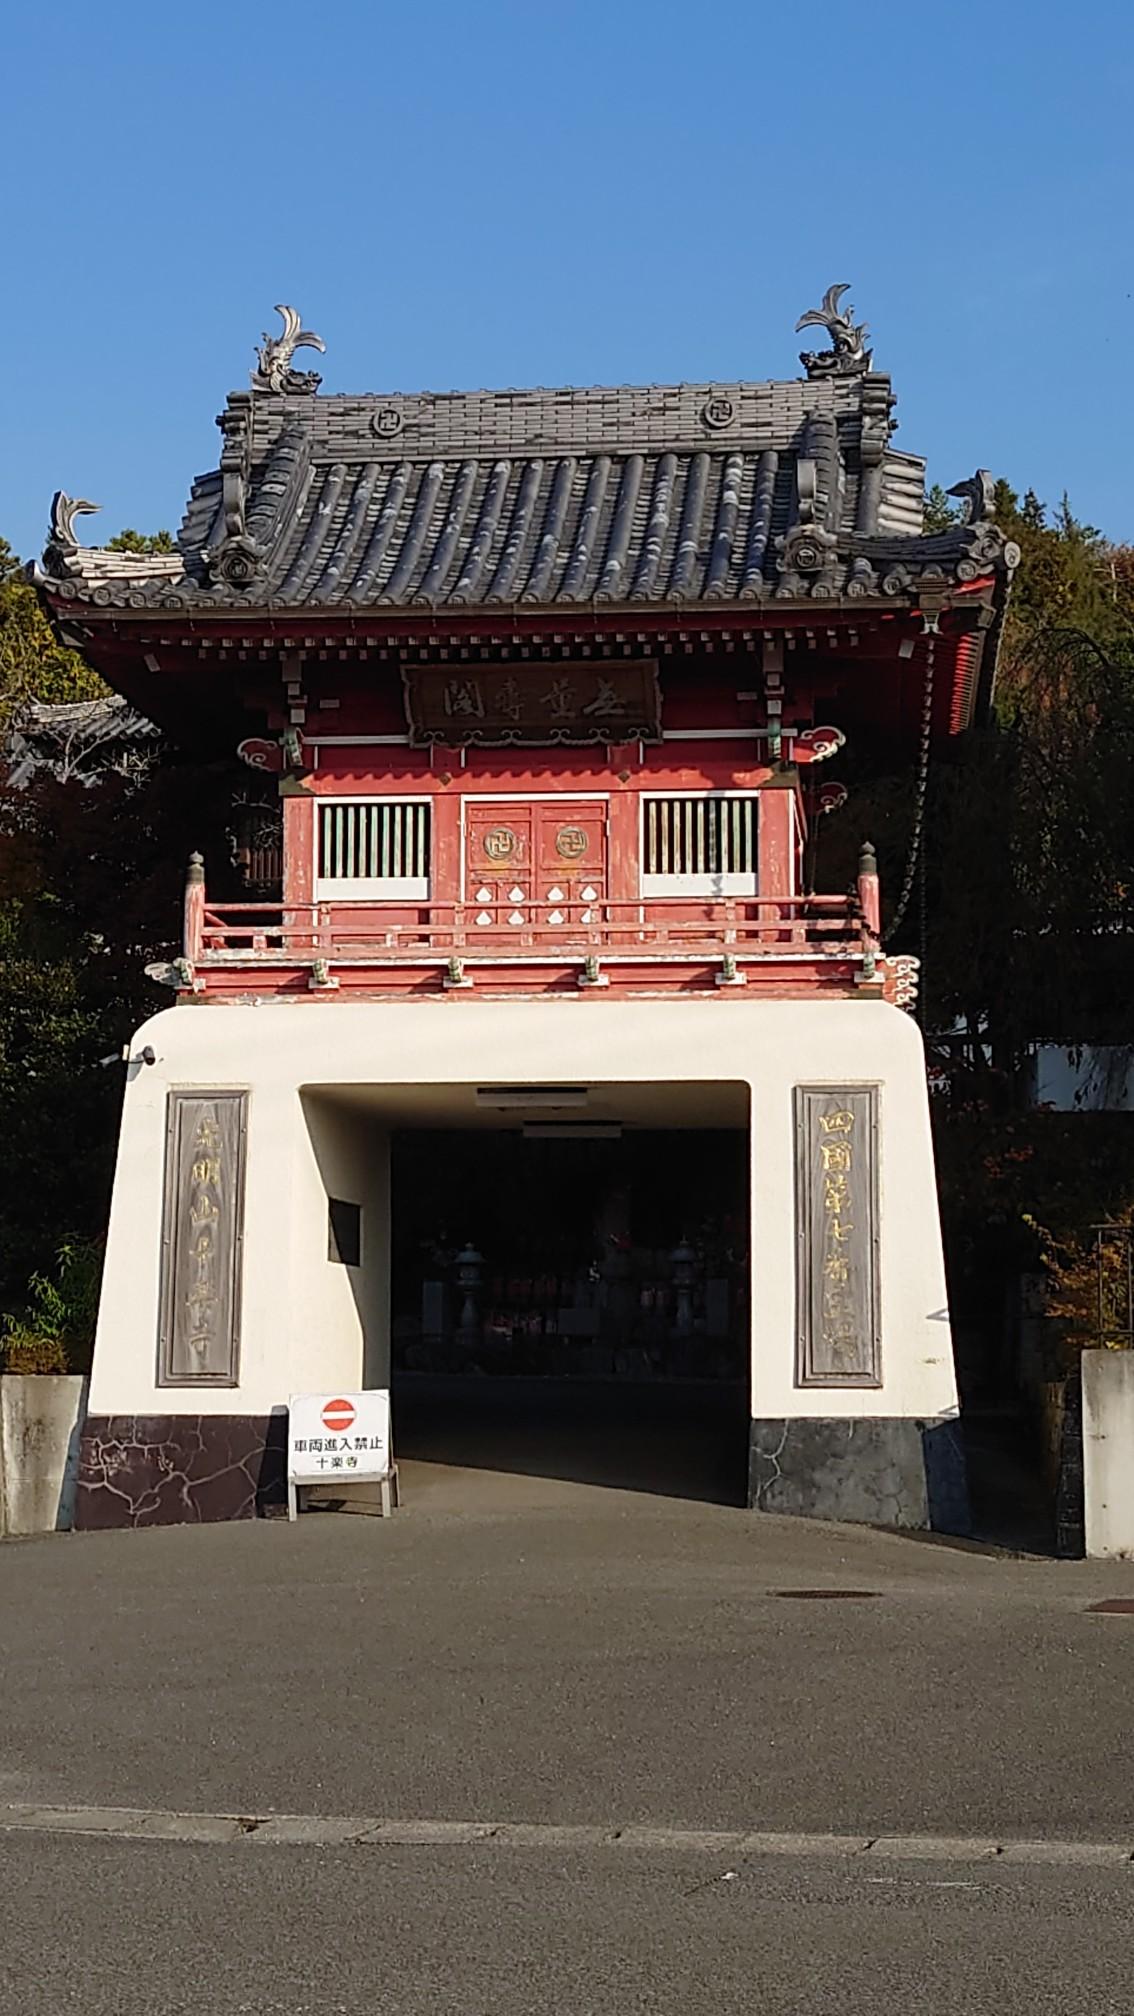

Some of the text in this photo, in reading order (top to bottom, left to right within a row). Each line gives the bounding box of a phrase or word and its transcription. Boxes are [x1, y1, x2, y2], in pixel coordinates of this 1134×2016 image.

[294, 1436, 383, 1452] 車両進入禁止
[316, 1456, 358, 1469] 十楽寺
